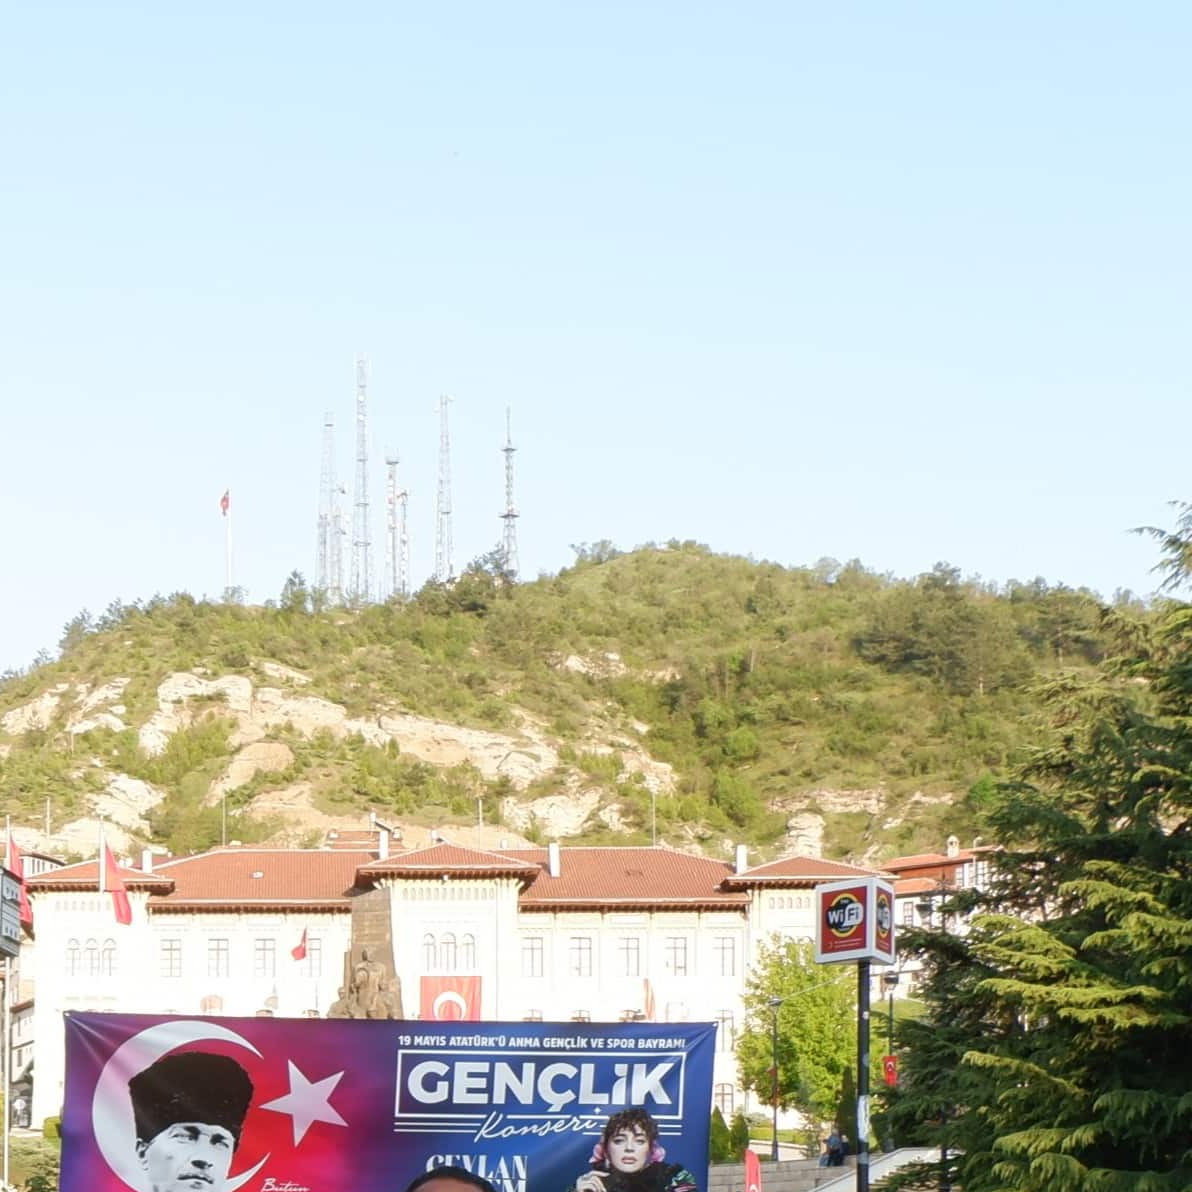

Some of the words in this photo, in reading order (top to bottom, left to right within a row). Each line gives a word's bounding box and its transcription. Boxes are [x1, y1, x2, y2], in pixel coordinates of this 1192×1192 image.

[397, 1035, 411, 1046] 19
[414, 1035, 447, 1047] MAYIS
[449, 1034, 506, 1048] ATATÜRK'Ü
[508, 1037, 541, 1049] ANMA
[543, 1036, 588, 1051] GENÇLİK
[590, 1038, 605, 1049] VE
[607, 1038, 636, 1049] SPOR
[637, 1038, 686, 1050] BAYRAMI
[473, 1107, 601, 1143] Konseri
